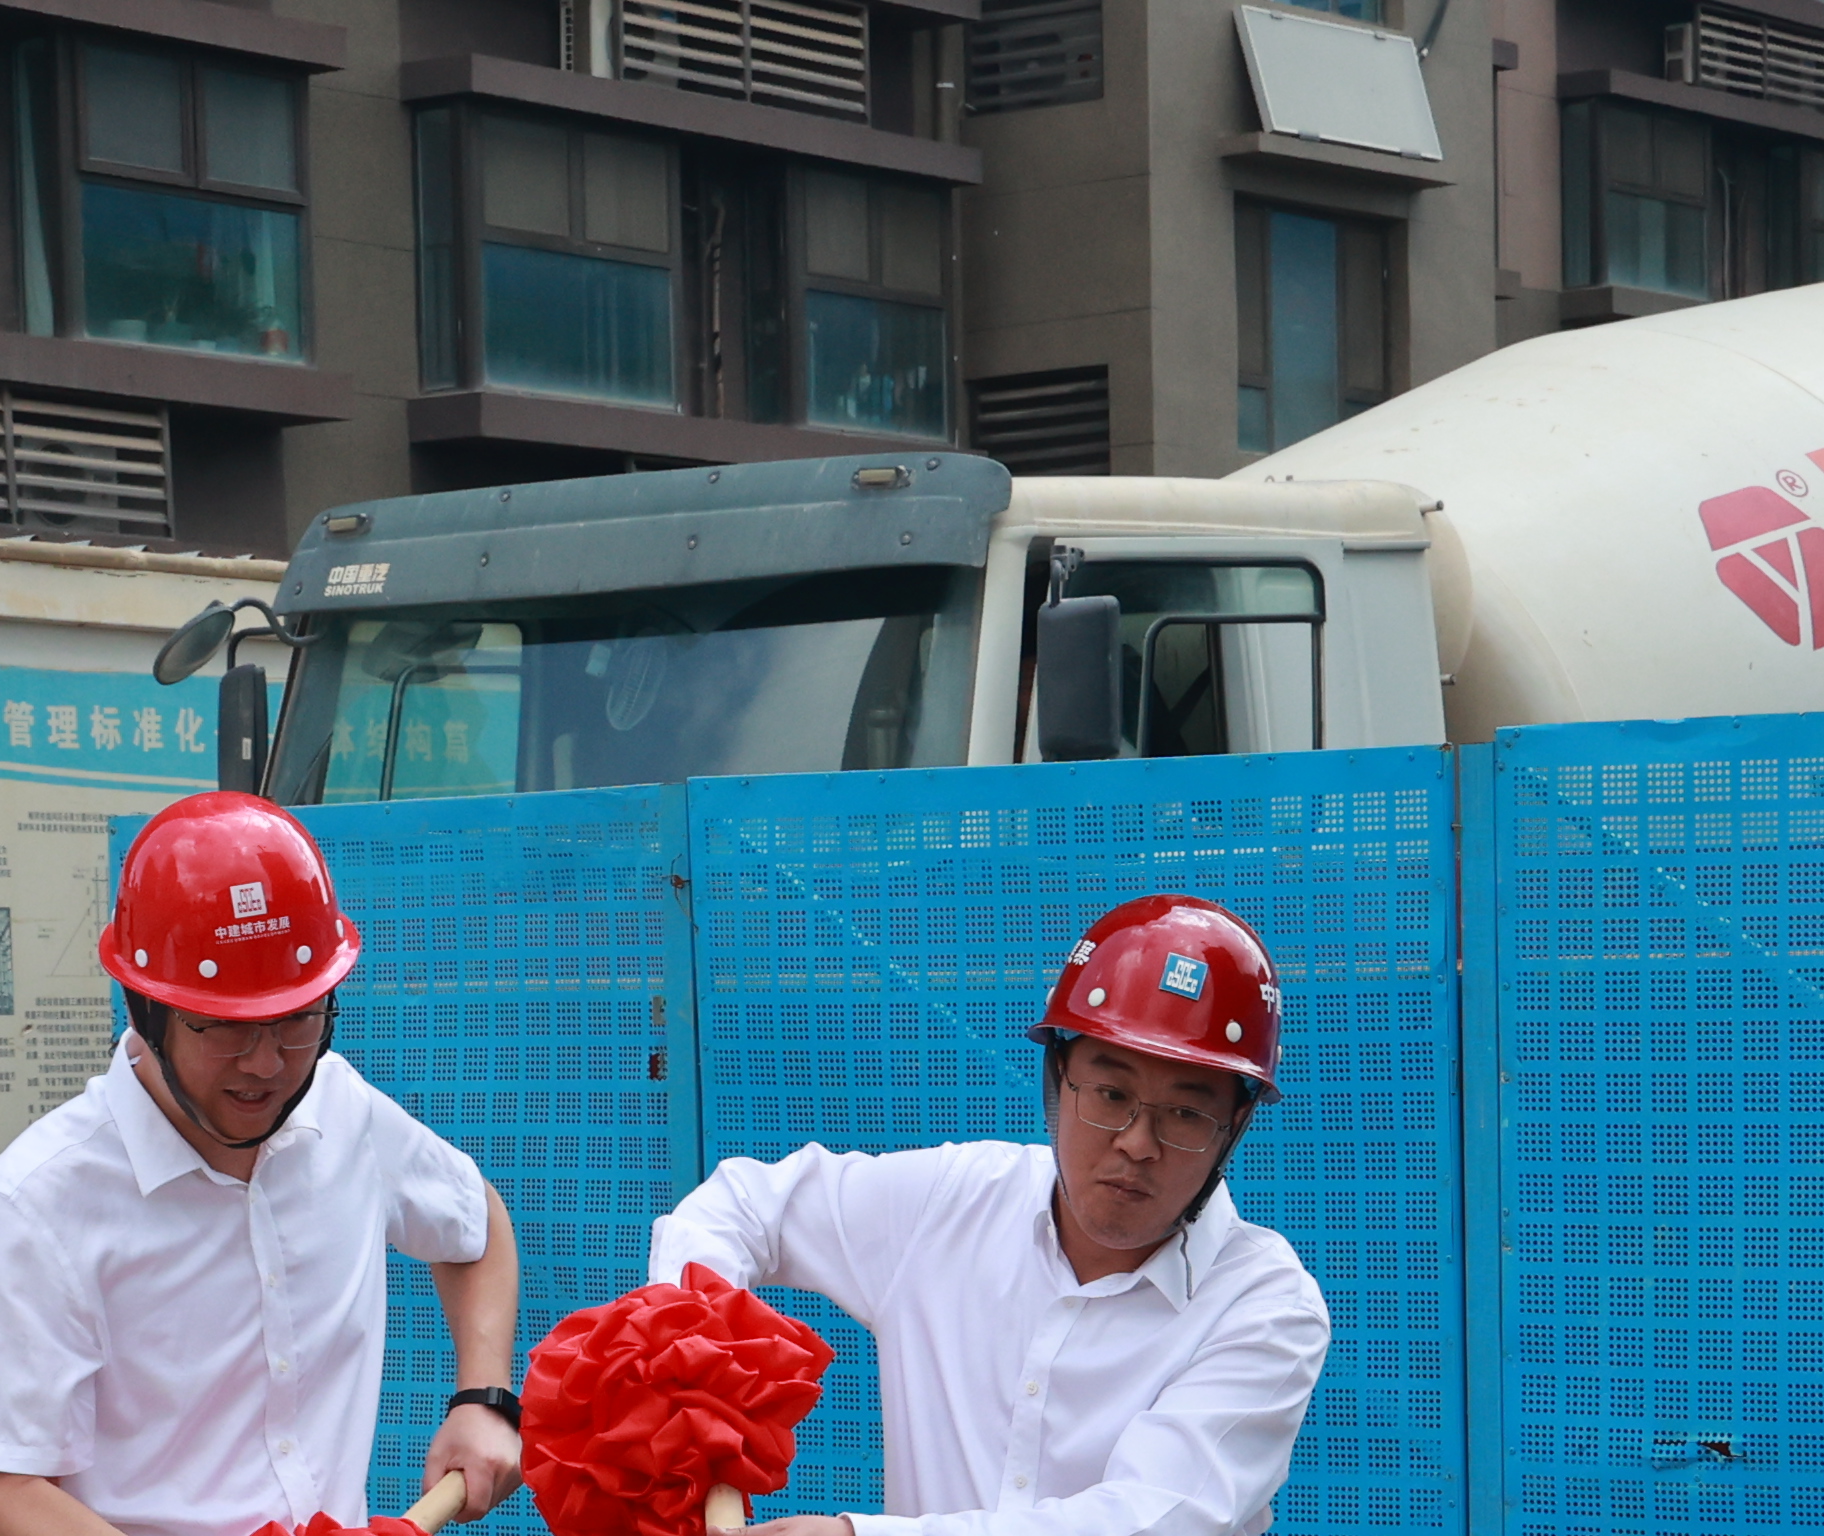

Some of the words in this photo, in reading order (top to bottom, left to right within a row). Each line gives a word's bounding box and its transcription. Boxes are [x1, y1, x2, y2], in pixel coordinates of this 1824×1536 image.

[328, 563, 390, 584] 中国重汽
[324, 582, 385, 597] SINOTRUK
[214, 916, 291, 939] 中建城市发展
